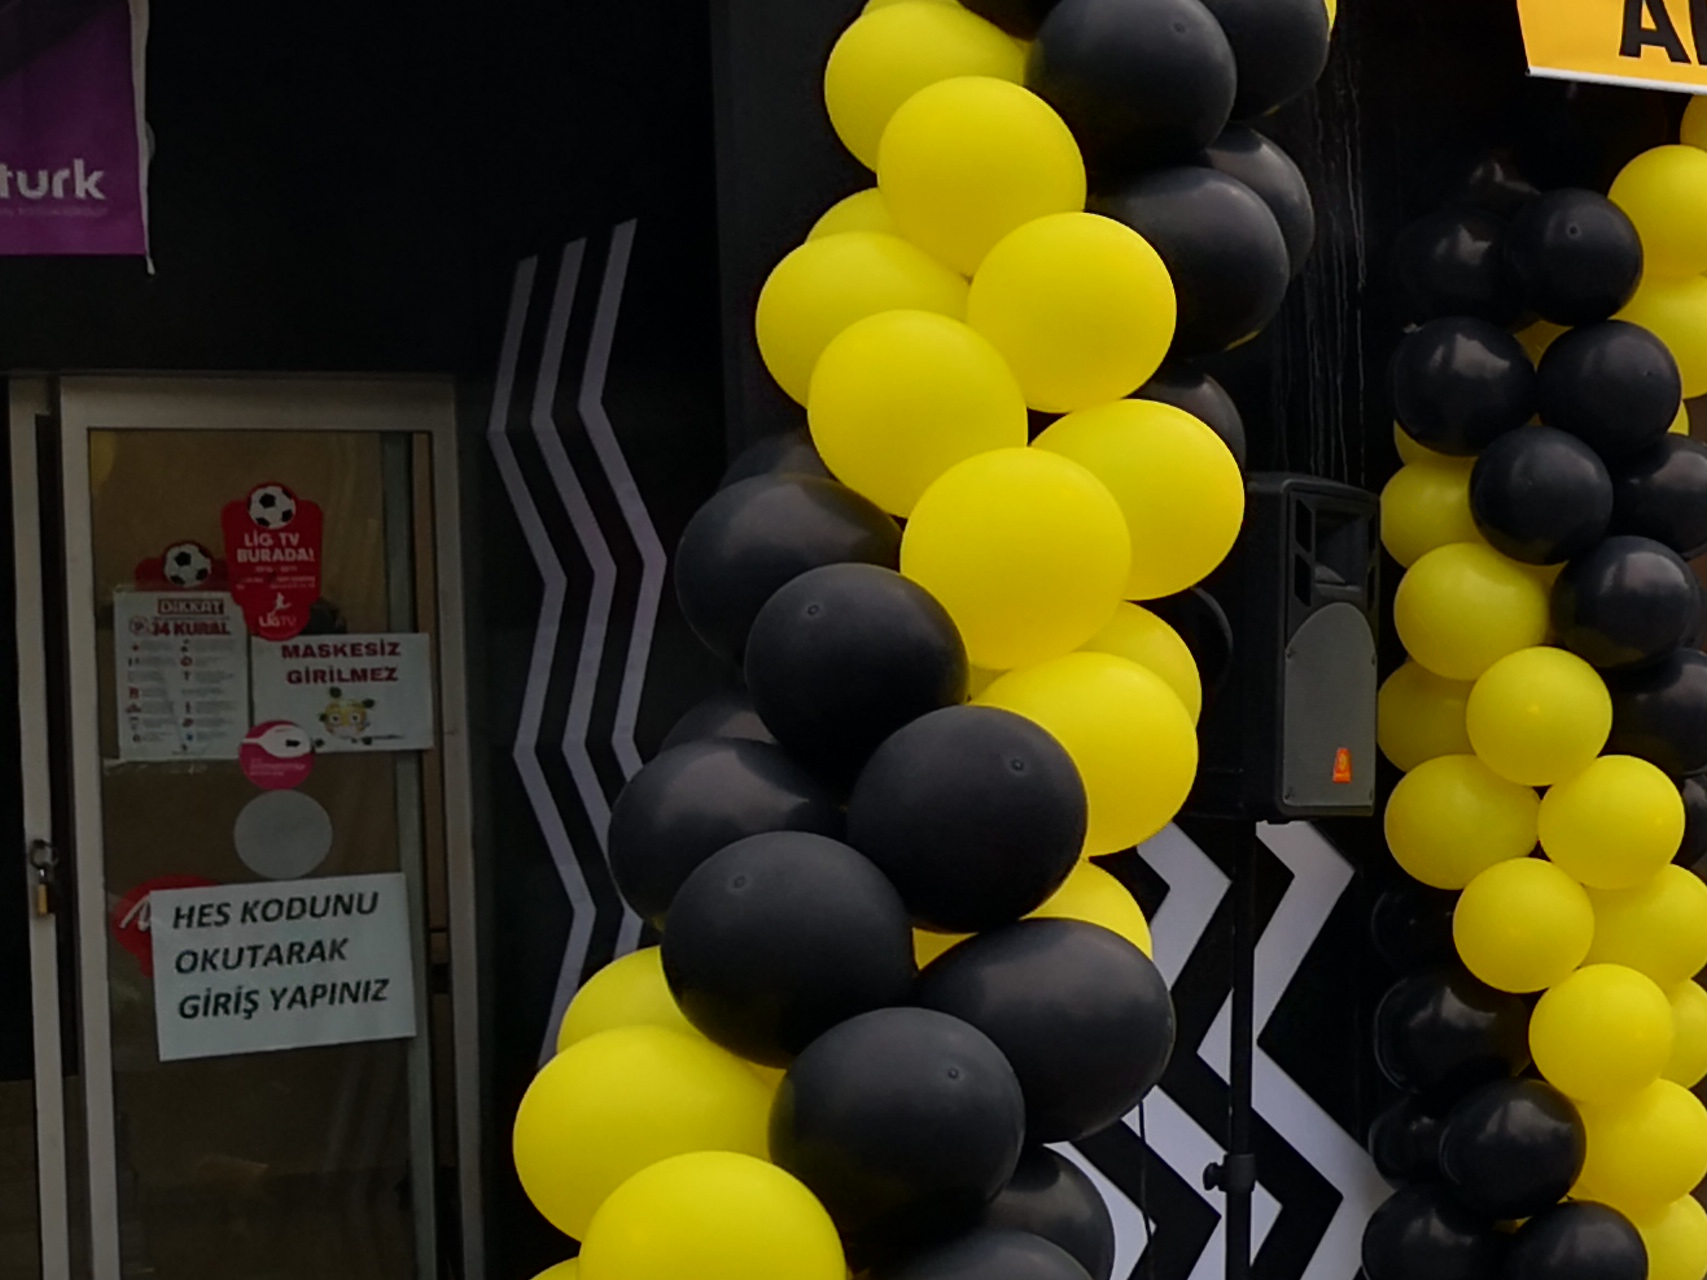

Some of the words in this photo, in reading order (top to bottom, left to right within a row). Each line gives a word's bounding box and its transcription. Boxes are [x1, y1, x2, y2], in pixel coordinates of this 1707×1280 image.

[243, 531, 275, 548] LİG
[277, 533, 300, 548] TV
[236, 546, 316, 564] BURADA!
[282, 638, 402, 660] MASKESİZ
[286, 665, 399, 685] GİRİLMEZ
[172, 902, 231, 929] HES
[240, 891, 380, 925] KODUNU
[175, 938, 349, 975] OKUTARAK
[178, 986, 259, 1020] GİRİŞ
[269, 977, 391, 1012] YAPINIZ
